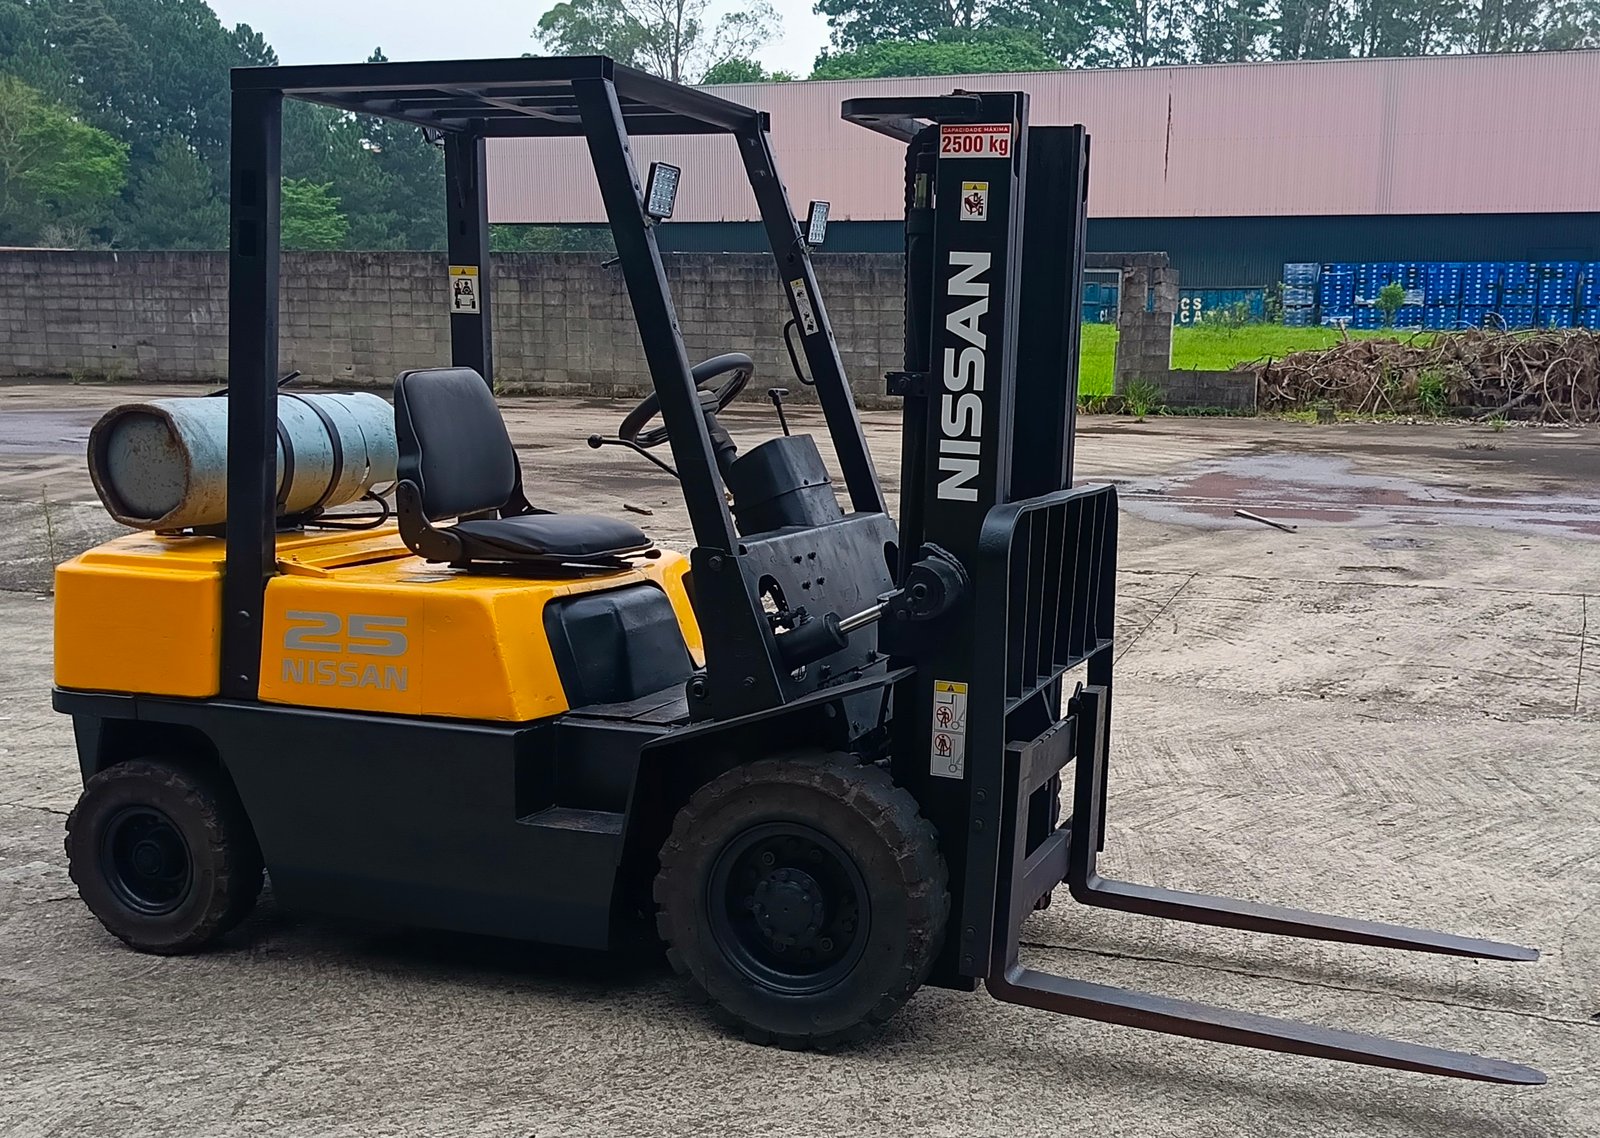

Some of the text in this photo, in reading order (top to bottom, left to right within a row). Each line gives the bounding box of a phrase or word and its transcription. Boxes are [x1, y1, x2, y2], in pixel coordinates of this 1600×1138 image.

[942, 135, 1008, 156] 2500 kg
[937, 251, 991, 502] NISSAN
[284, 609, 408, 657] 25
[282, 657, 408, 691] NISSAN
